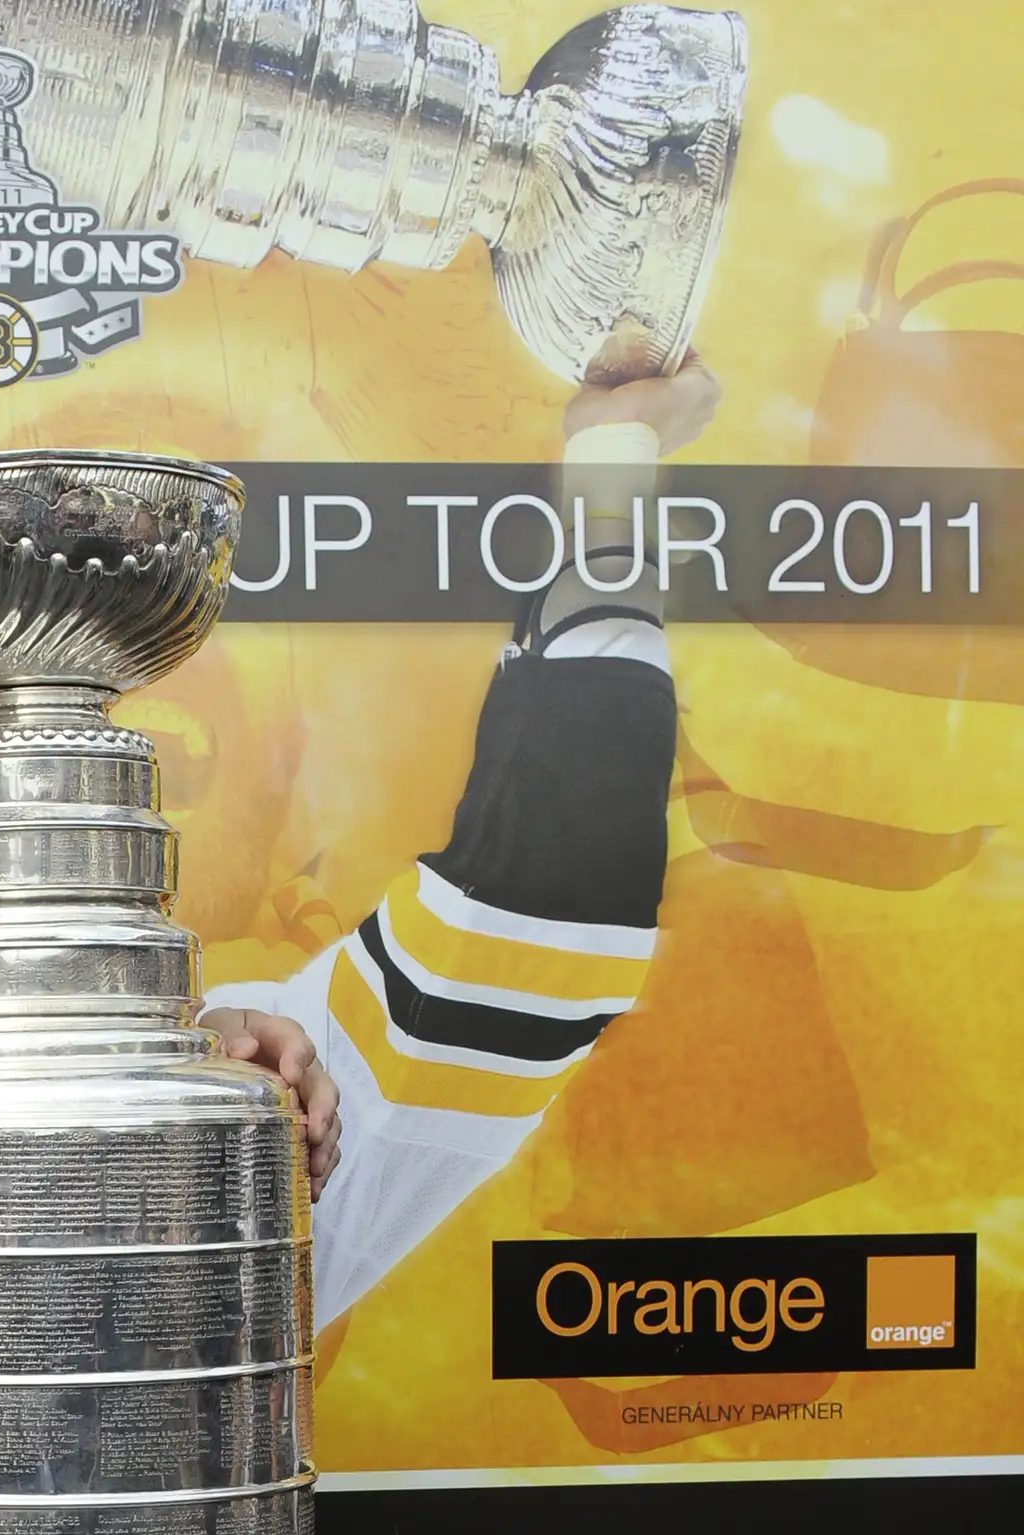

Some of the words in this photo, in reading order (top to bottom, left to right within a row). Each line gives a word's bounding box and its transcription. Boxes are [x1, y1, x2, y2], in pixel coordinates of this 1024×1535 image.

[25, 208, 95, 236] CUP
[228, 494, 373, 592] UP
[406, 494, 728, 593] TOUR
[767, 499, 980, 595] 2011
[535, 1261, 826, 1353] Orange
[870, 1325, 945, 1345] orange
[621, 1401, 745, 1425] GENERÁLNY
[752, 1402, 844, 1422] PARTNER
